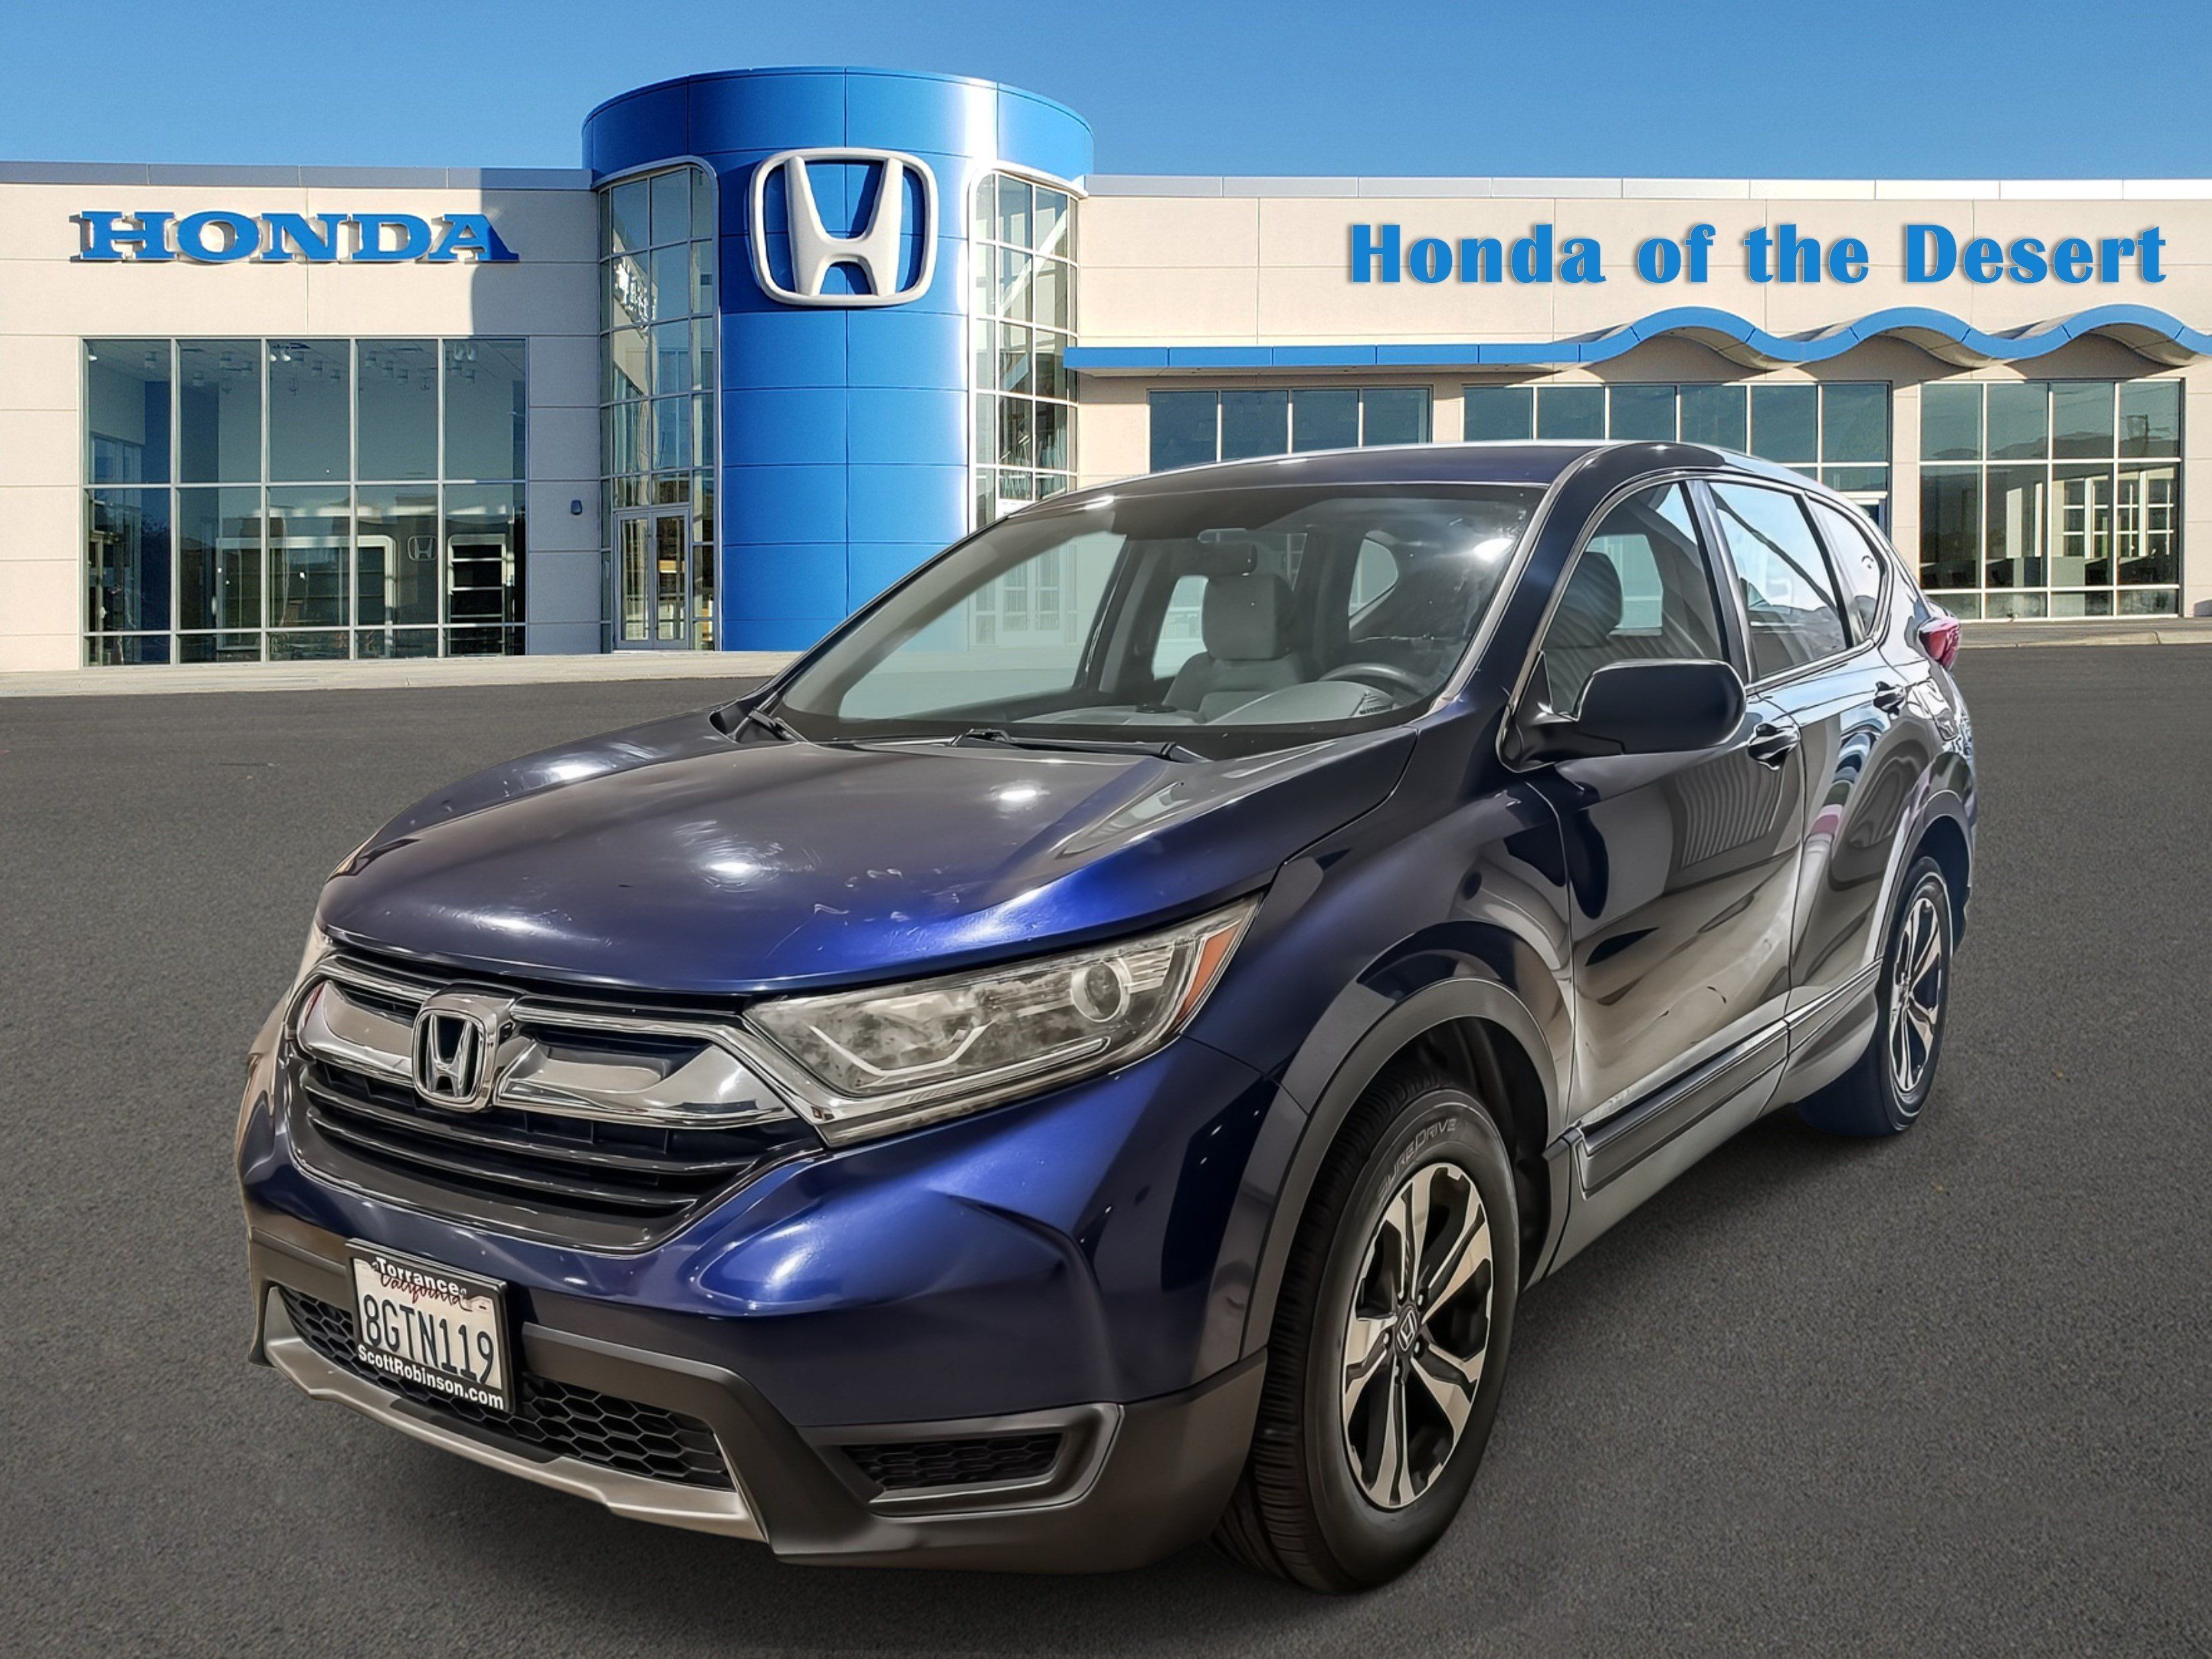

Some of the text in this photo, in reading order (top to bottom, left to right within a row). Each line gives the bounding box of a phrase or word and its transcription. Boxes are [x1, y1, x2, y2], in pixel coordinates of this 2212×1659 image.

[79, 211, 519, 261] HONDA
[1351, 223, 2166, 284] Honda of the Desert
[375, 1256, 460, 1296] Torrance
[363, 1294, 494, 1384] 8GTN119
[357, 1343, 504, 1410] ScottRobinson.com
